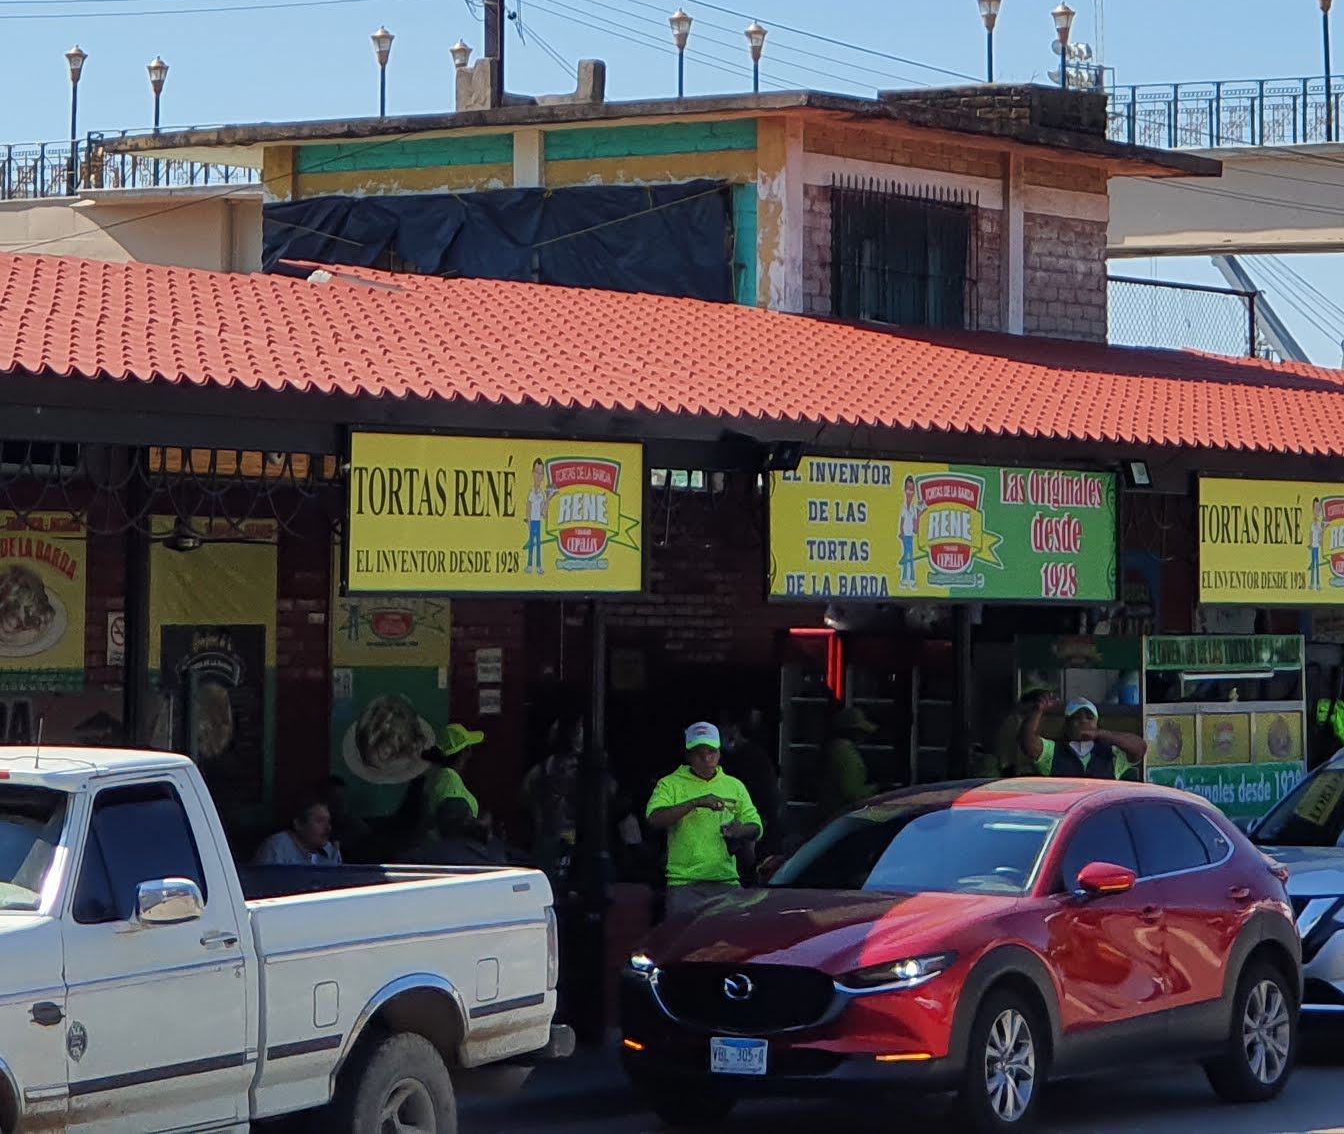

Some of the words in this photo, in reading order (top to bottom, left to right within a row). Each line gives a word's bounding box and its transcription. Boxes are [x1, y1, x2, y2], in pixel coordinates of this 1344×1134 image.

[354, 467, 447, 517] TORTAS
[454, 455, 516, 517] RENÉ
[1000, 468, 1025, 504] Las
[1028, 469, 1103, 510] Originales
[559, 492, 608, 525] RENÉ
[808, 500, 828, 522] DE
[836, 501, 867, 523] LAS
[1199, 505, 1259, 544] TORTAS
[1264, 495, 1303, 544] RENÉ
[1031, 511, 1083, 553] desde
[0, 537, 16, 558] DE
[18, 537, 32, 556] LA
[35, 540, 77, 580] BARDA
[356, 550, 373, 572] EL
[376, 550, 448, 573] INVENTOR
[450, 551, 491, 573] DESDE
[495, 551, 520, 573] 1928
[807, 540, 869, 561] TORTAS
[786, 574, 804, 595] DE
[812, 574, 831, 596] LA
[838, 575, 889, 596] BARDA
[1040, 562, 1079, 598] 1928
[1202, 571, 1213, 589] EL
[1215, 571, 1258, 589] INVENTOR
[1261, 572, 1288, 589] DESDE
[1291, 572, 1306, 589] 1928
[1238, 772, 1271, 803] desde
